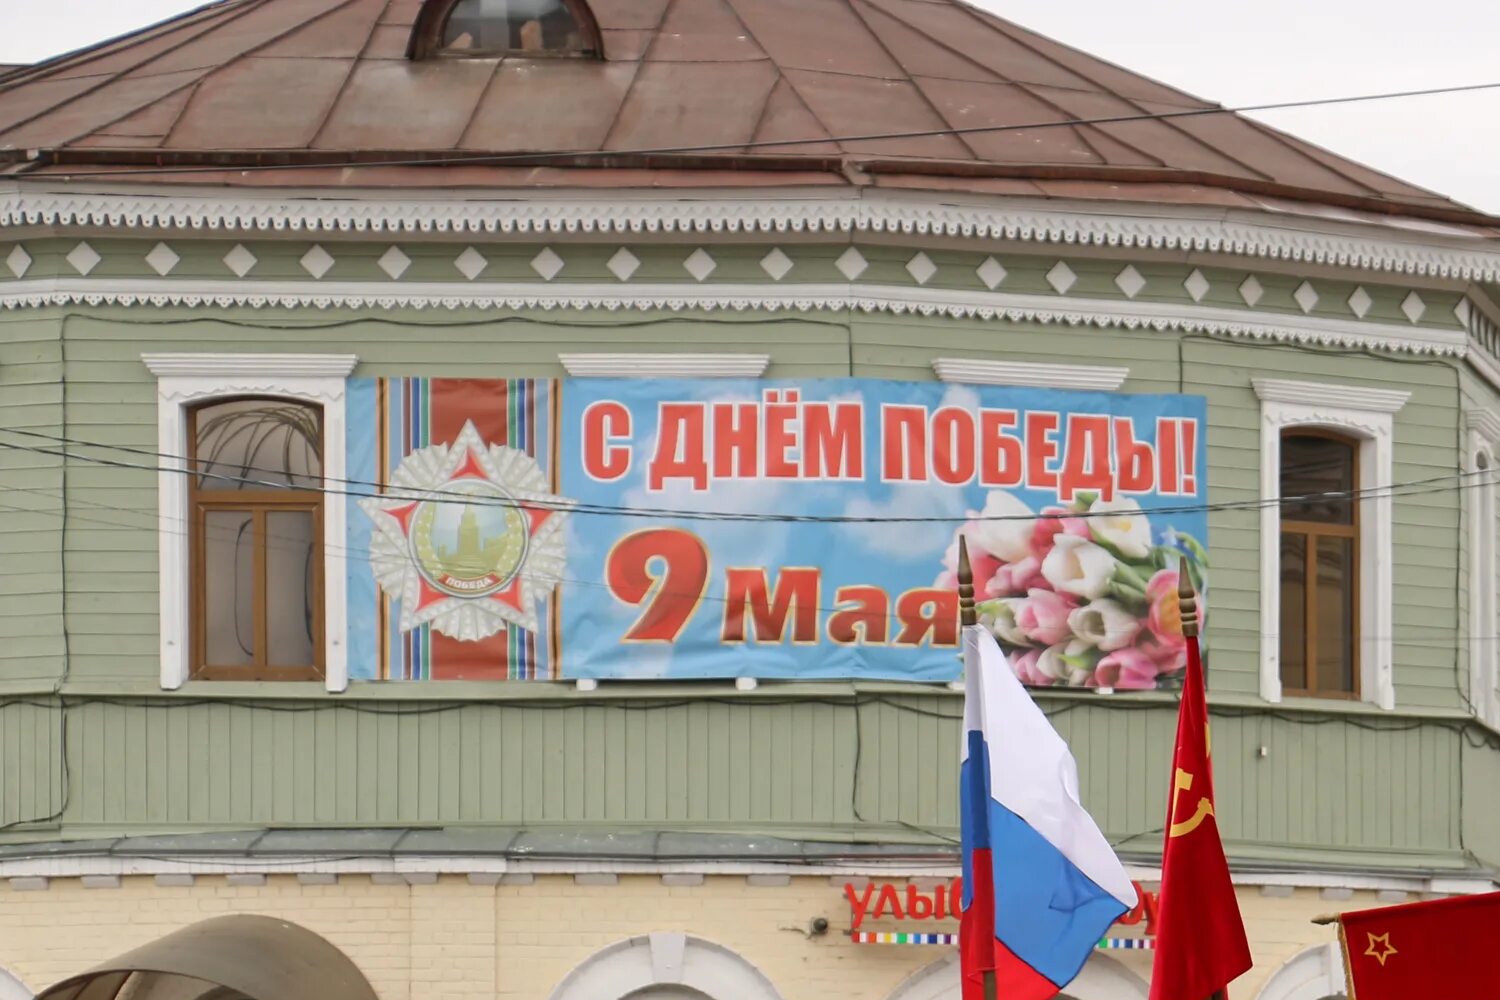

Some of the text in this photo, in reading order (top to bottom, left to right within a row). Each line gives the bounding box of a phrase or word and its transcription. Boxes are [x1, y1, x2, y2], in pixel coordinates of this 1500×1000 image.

[582, 389, 1197, 503] С ДНЁМ ПОБЕДЫ!
[604, 526, 961, 647] 9 Мая
